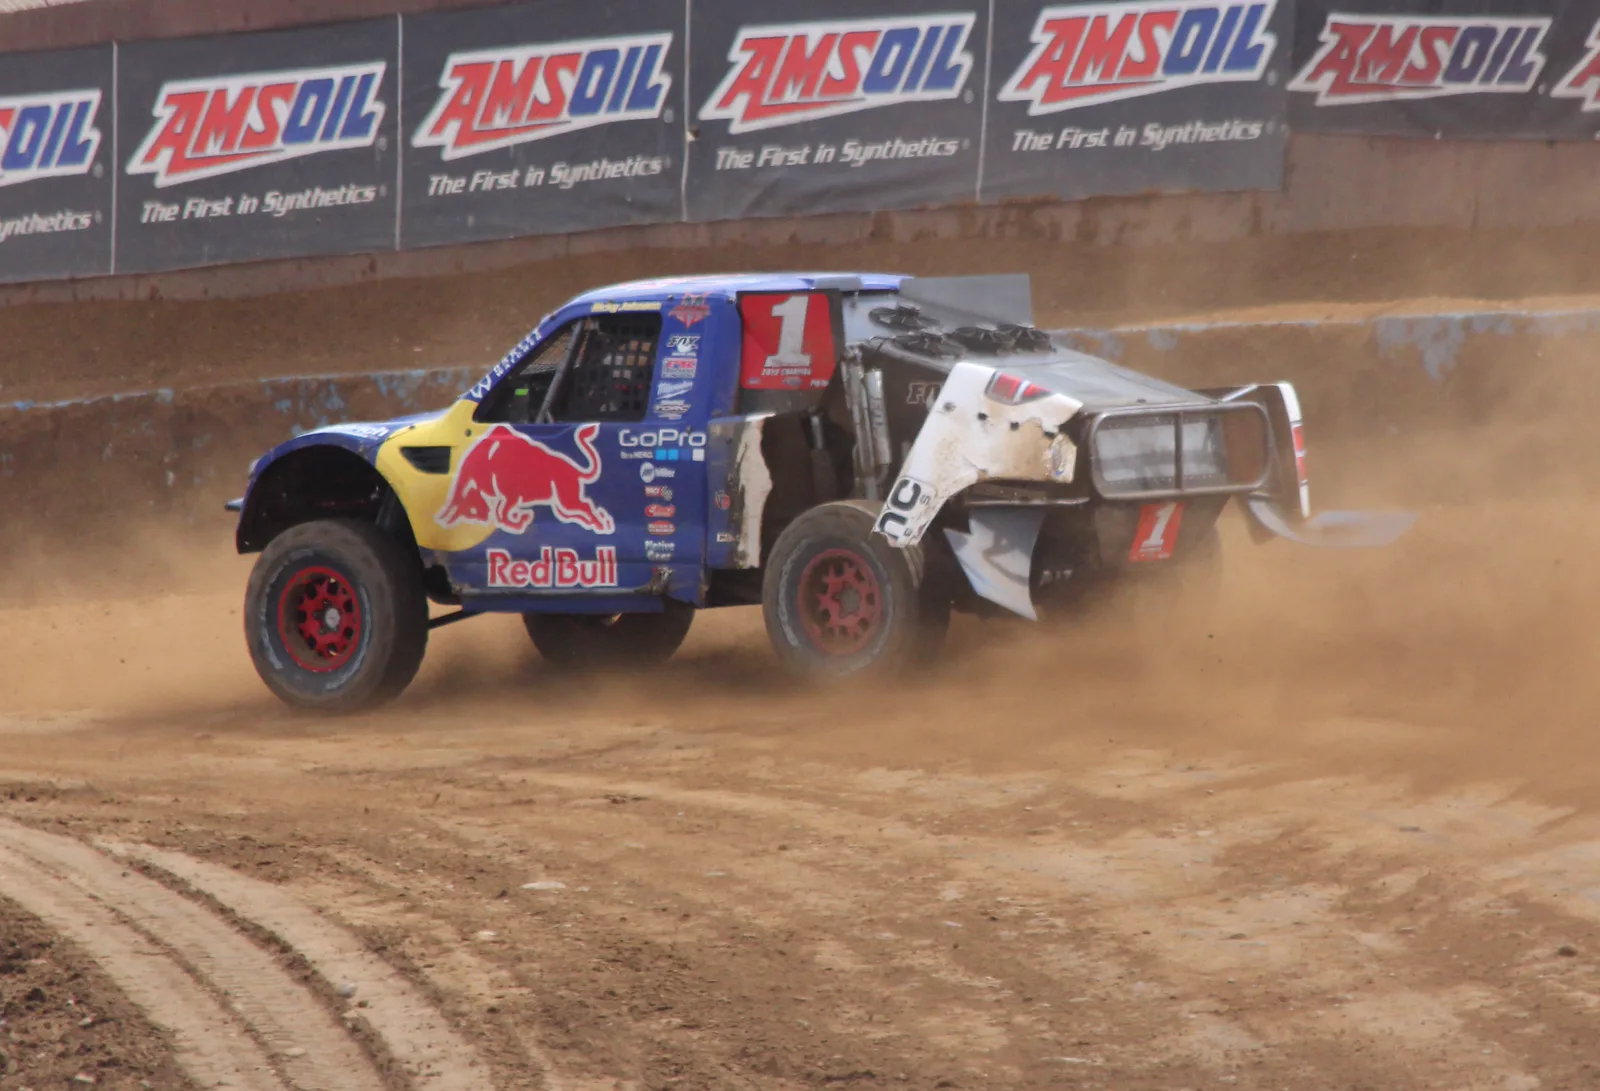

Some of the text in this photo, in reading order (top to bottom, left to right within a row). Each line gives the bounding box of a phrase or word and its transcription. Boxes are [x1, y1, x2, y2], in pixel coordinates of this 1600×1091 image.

[701, 14, 974, 131] AMSOIL
[1000, 1, 1276, 113] AMSOIL
[1289, 14, 1550, 104] AMSOIL
[413, 34, 671, 158] AMSOIL
[130, 63, 385, 185] AMSOIL
[1012, 119, 1263, 152] The First in Synthetics
[428, 155, 663, 196] The First in Synthetics
[715, 136, 959, 171] The First in Synthetics
[141, 184, 376, 223] The First in Synthetics
[764, 295, 811, 367] 1
[618, 429, 706, 447] GoPro
[1140, 502, 1177, 548] 1
[487, 546, 618, 586] Red Bull
